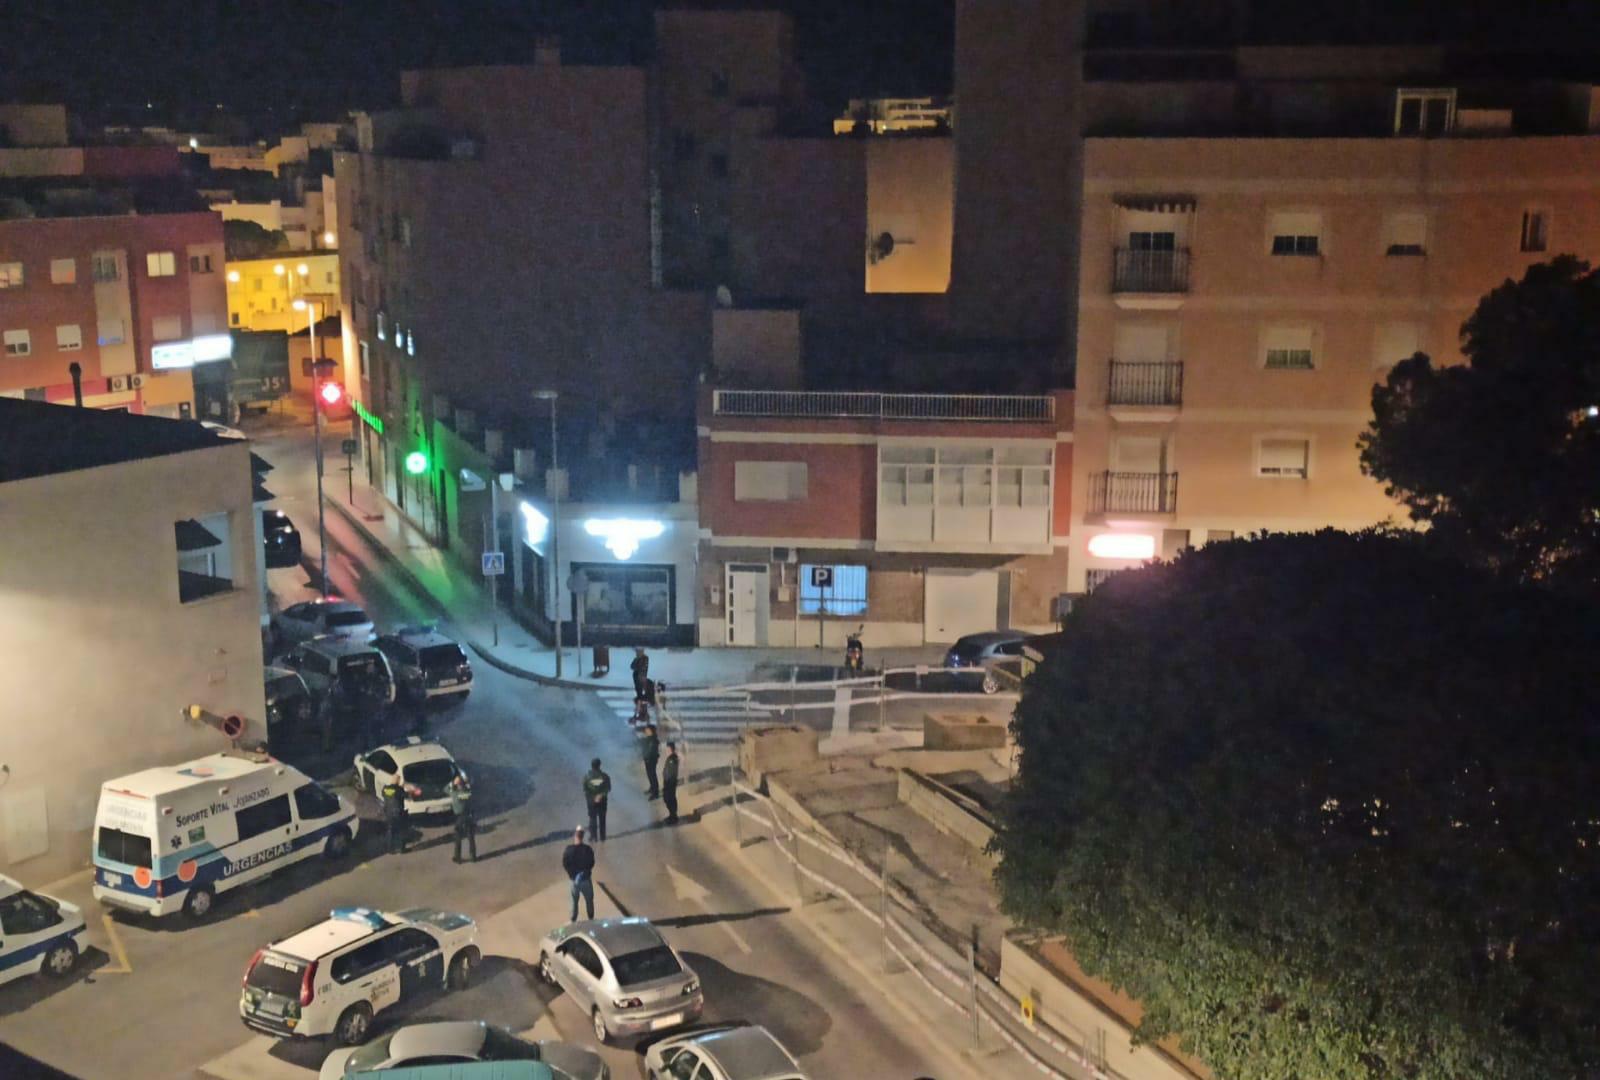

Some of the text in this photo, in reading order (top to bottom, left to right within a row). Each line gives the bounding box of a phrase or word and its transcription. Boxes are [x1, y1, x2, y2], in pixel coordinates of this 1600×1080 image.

[815, 569, 828, 585] P
[176, 808, 208, 828] SOPORTE
[210, 802, 230, 816] VITAL
[223, 842, 293, 876] URGENCIAS
